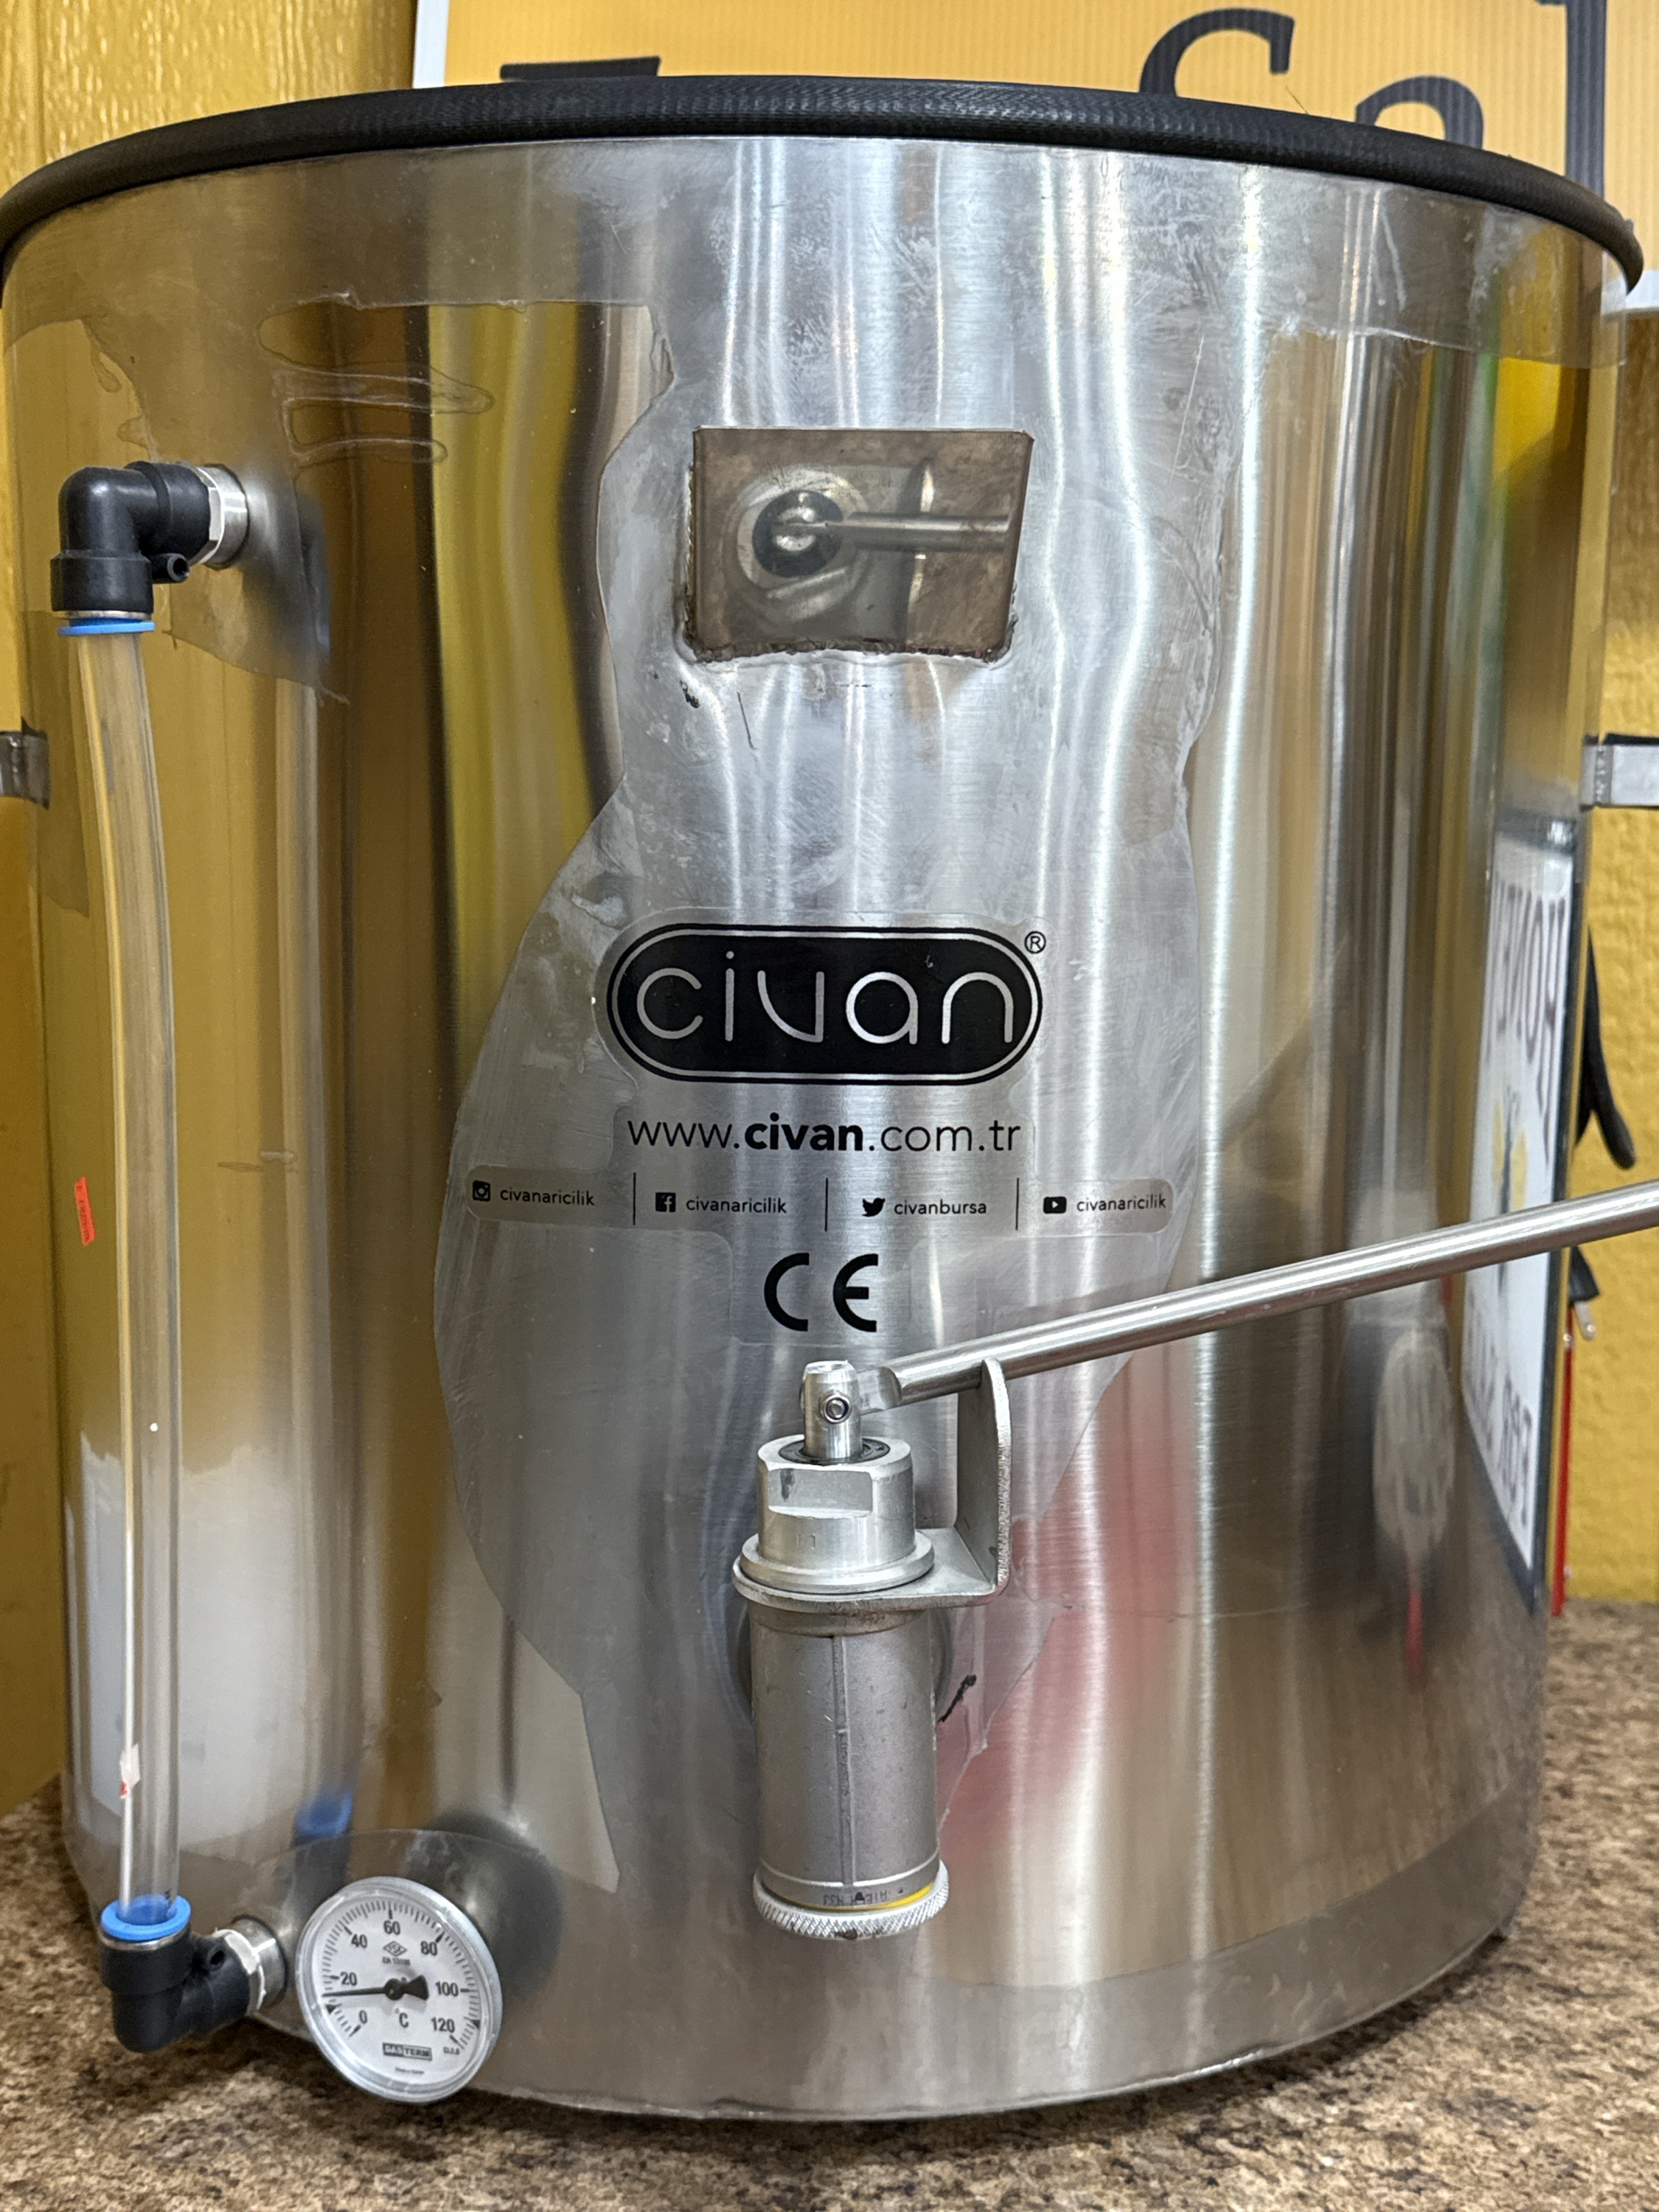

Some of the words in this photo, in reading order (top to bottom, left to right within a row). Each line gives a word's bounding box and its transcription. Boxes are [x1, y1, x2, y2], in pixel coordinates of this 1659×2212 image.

[636, 950, 1014, 1045] civan
[627, 1112, 1022, 1152] www.civan.com.tr
[499, 1187, 596, 1206] civanaricilik
[685, 1195, 788, 1214] civanaricilik
[1075, 1193, 1167, 1213] civanaricilik
[893, 1197, 988, 1217] civanbursa
[763, 1252, 879, 1334] CE
[383, 1920, 401, 1935] 60
[351, 1934, 368, 1949] 40
[420, 1941, 438, 1956] 80
[340, 1972, 358, 1986] 20
[435, 1981, 459, 1997] 100
[358, 2009, 369, 2025] 0
[431, 2017, 456, 2034] 120
